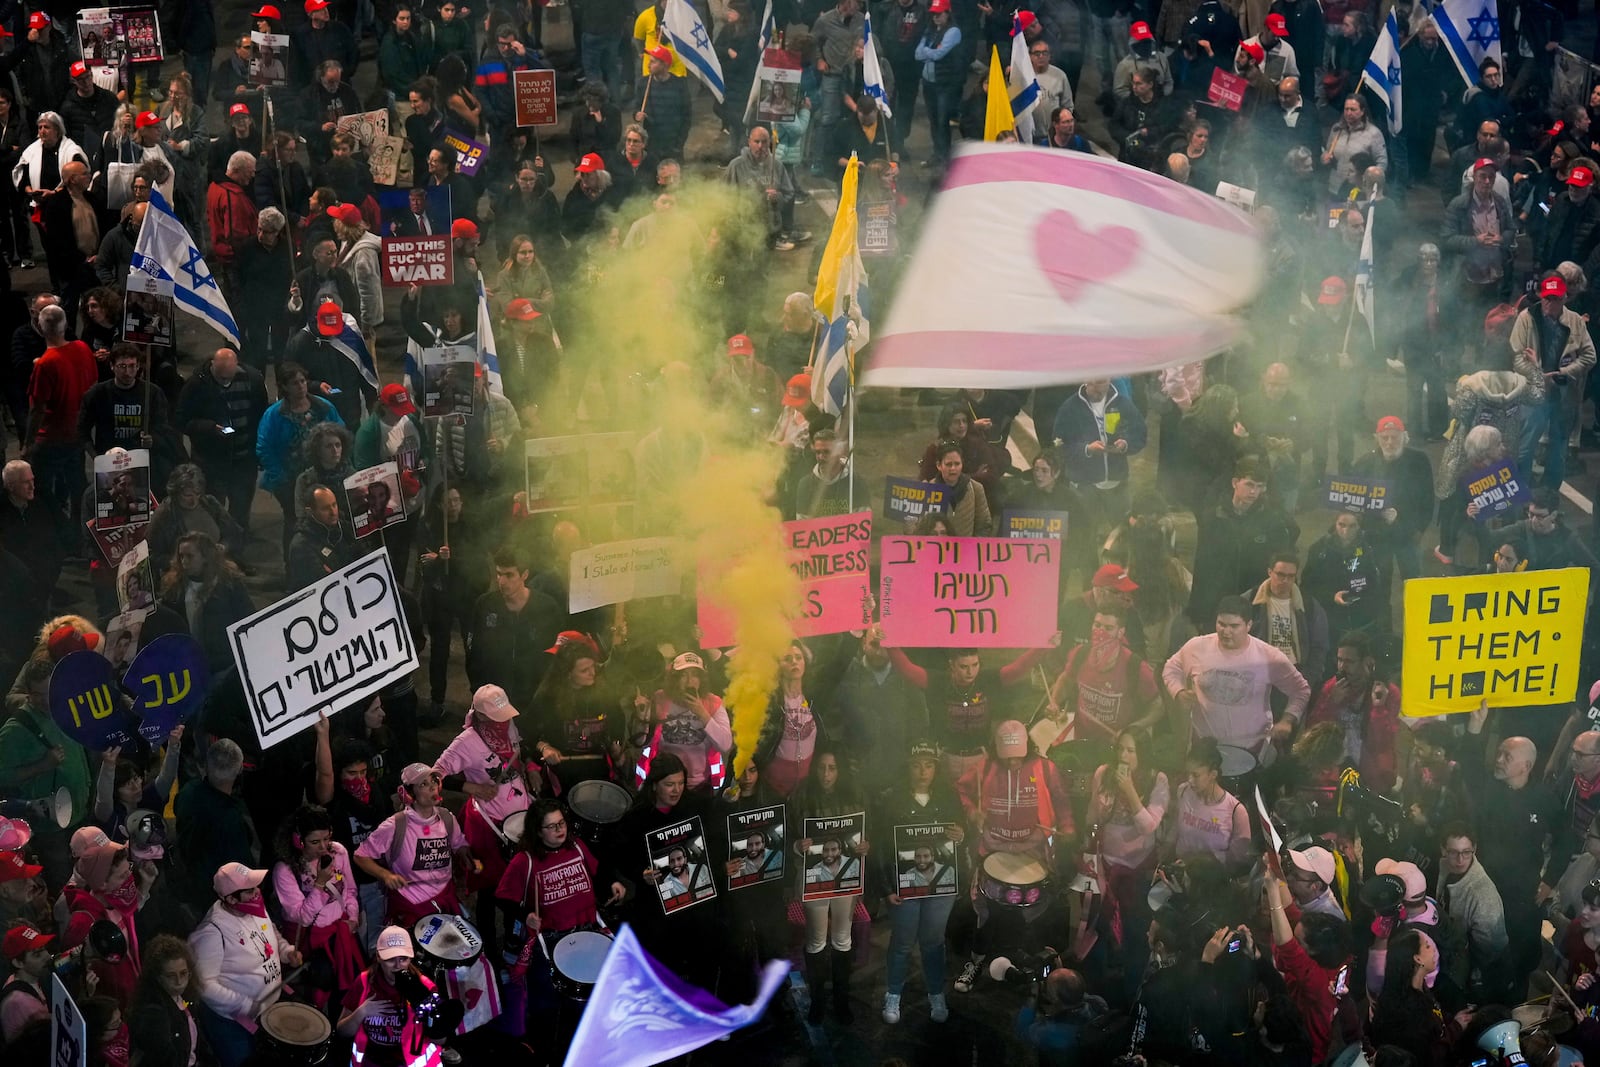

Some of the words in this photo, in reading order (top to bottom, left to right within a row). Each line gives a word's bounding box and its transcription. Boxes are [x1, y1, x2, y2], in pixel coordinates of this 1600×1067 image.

[518, 80, 541, 88] נתרגל
[387, 242, 415, 253] END
[416, 240, 446, 251] THIS
[388, 263, 447, 282] WAR
[113, 403, 125, 416] הם
[126, 403, 142, 416] למה
[1499, 467, 1513, 485] כן,
[891, 484, 927, 501] עסקה
[1330, 480, 1368, 495] עסקה
[1369, 486, 1387, 499] כן,
[1468, 473, 1498, 497] עסקה
[1503, 479, 1520, 499] כן,
[890, 497, 924, 514] שלום
[926, 491, 943, 504] כן,
[1328, 491, 1365, 507] שלום
[1366, 497, 1385, 510] כן,
[1473, 490, 1506, 510] שלום
[1010, 516, 1045, 531] עסקה
[1046, 517, 1063, 531] כן,
[792, 519, 871, 549] EADERS
[888, 540, 959, 565] ויריב
[977, 542, 1051, 572] גדעון
[583, 566, 588, 579] 1
[592, 563, 618, 578] State
[620, 561, 631, 573] of
[933, 571, 1009, 604] תשיגו
[1428, 586, 1561, 625] BRING
[283, 571, 388, 663] כולם
[934, 606, 998, 635] חדר
[1428, 629, 1541, 661] THEM
[257, 617, 404, 724] הומניטרים
[1429, 663, 1559, 700] HOME!
[746, 812, 762, 824] עדיין
[824, 820, 840, 830] עדיין
[664, 827, 680, 840] עדיין
[914, 827, 931, 837] עדיין
[542, 863, 583, 885] PINKFRONT
[543, 887, 568, 902] הורודה
[569, 881, 589, 895] החזית
[262, 959, 278, 974] THE
[264, 971, 281, 985] WAR
